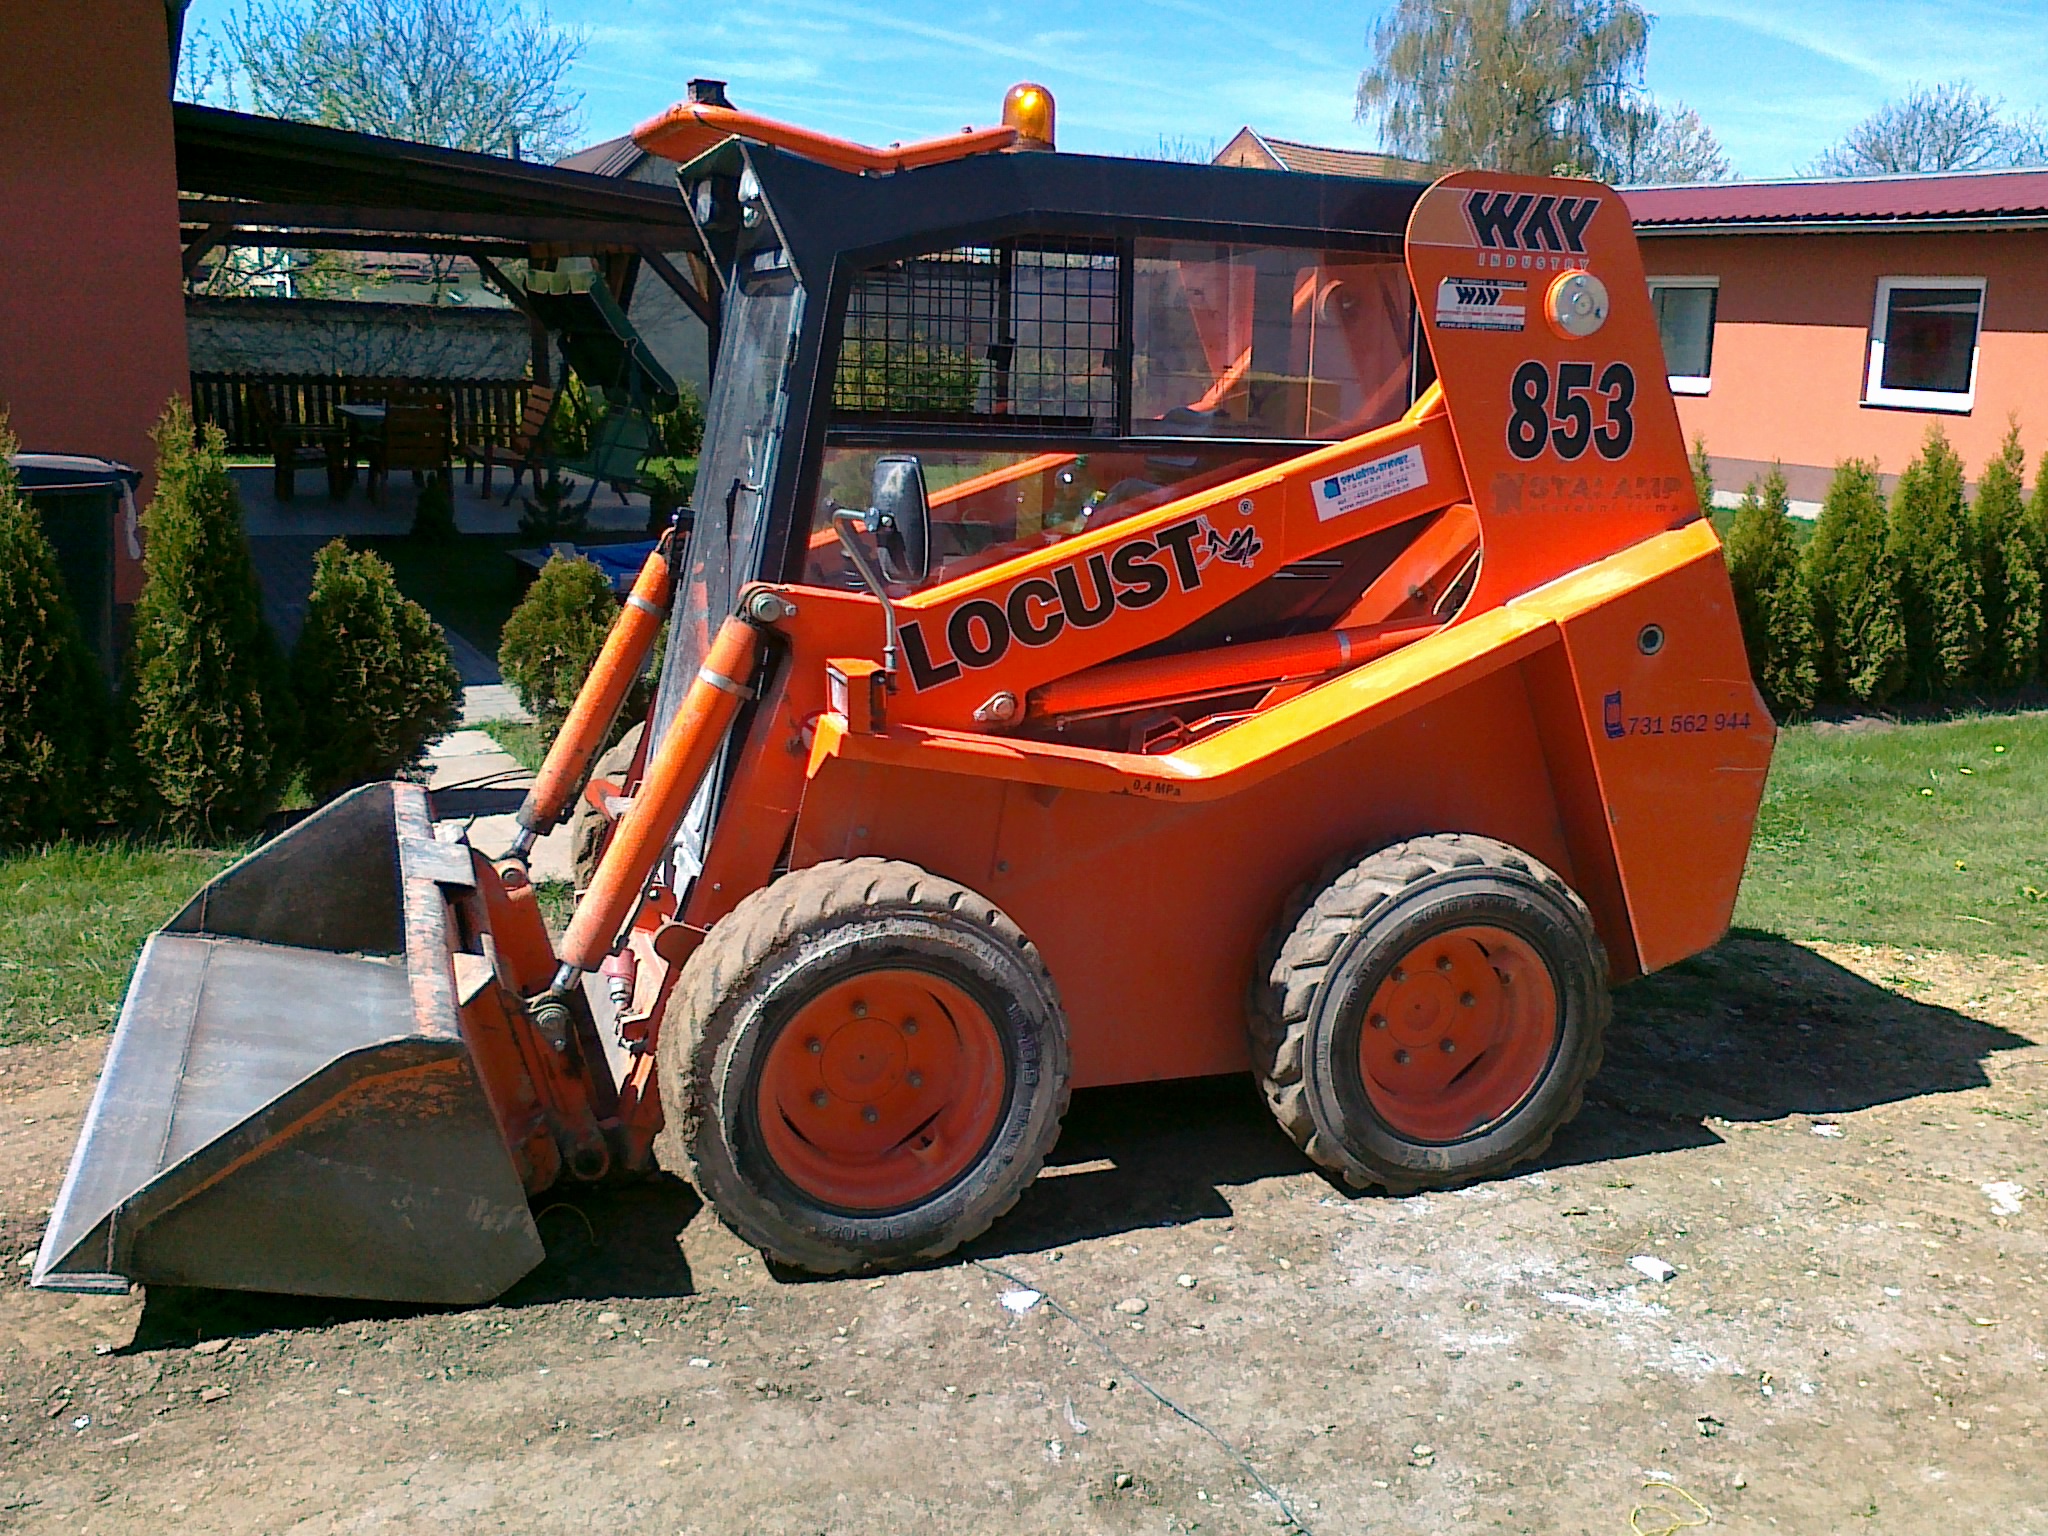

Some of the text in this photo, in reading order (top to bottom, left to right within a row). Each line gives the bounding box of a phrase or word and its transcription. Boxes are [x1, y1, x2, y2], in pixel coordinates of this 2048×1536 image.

[1465, 189, 1602, 254] WAY
[1478, 252, 1590, 271] INDUSTRY
[1456, 286, 1500, 306] WAY
[1506, 360, 1636, 462] 853
[896, 515, 1202, 694] LOCUST
[1628, 712, 1751, 735] 731 562 944
[1133, 779, 1181, 796] 0,4 MPa
